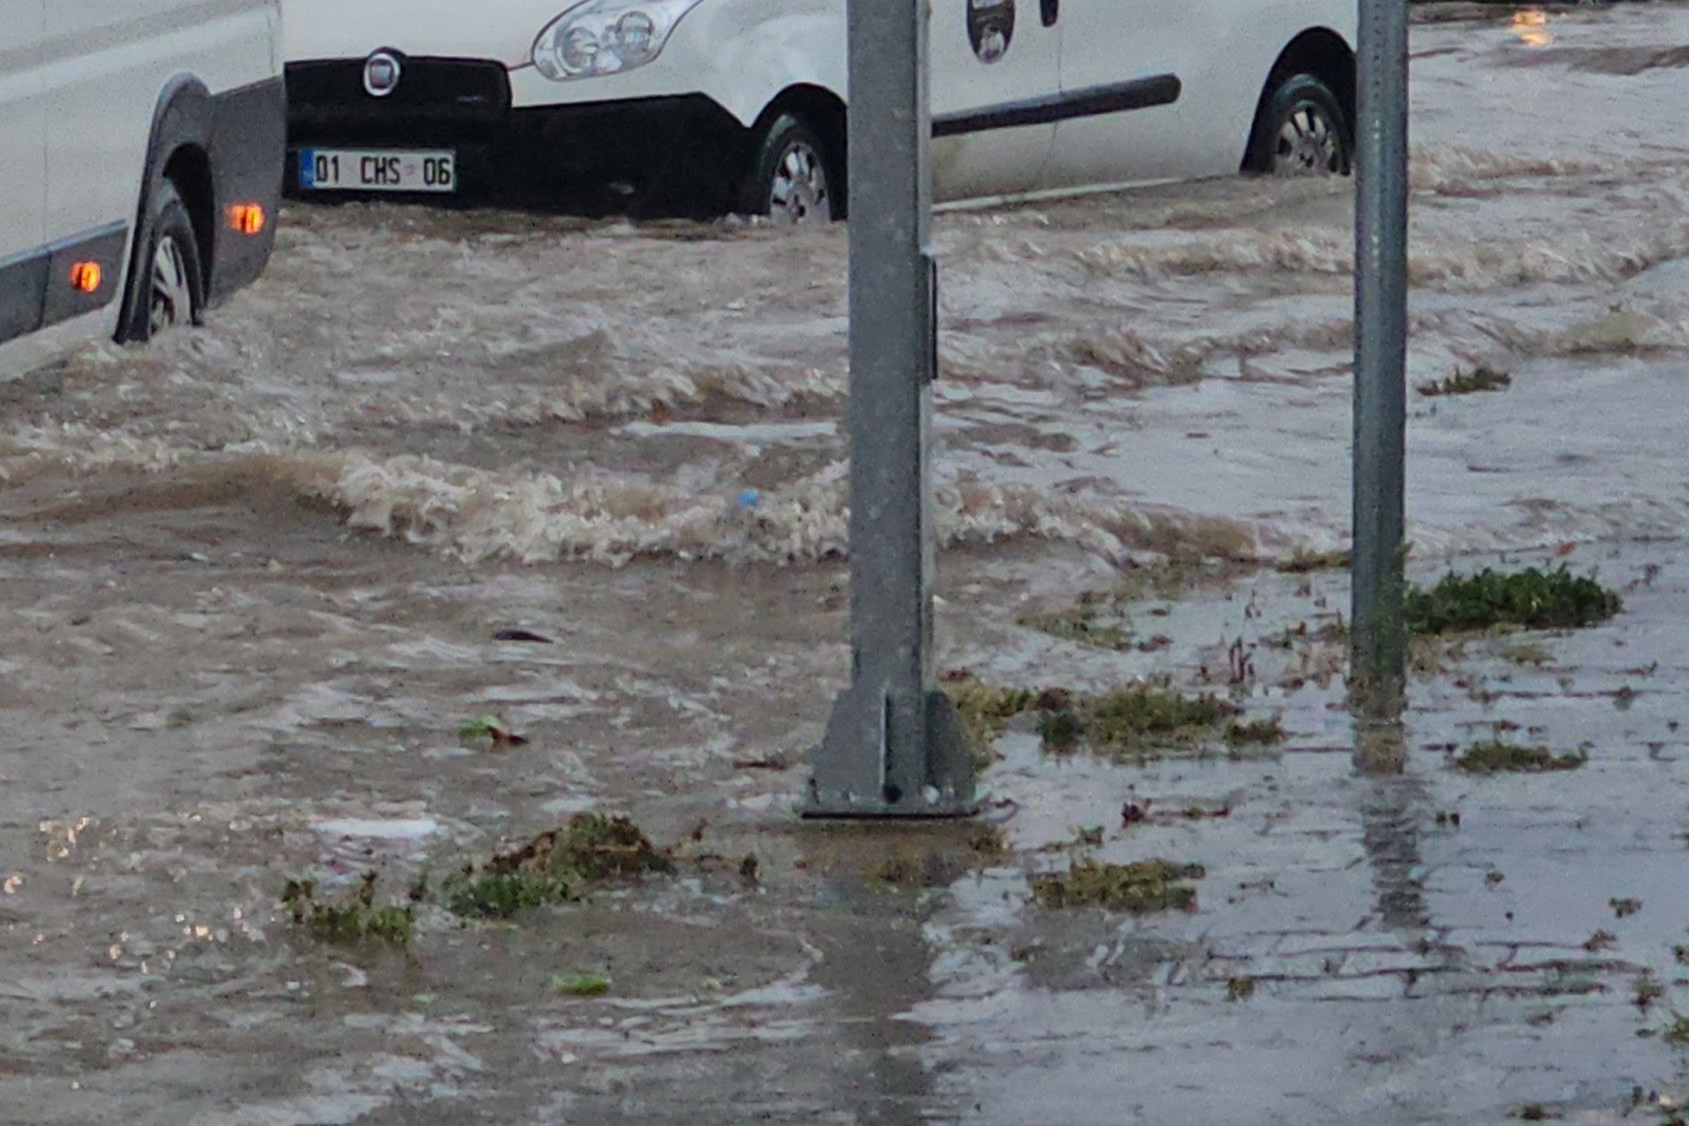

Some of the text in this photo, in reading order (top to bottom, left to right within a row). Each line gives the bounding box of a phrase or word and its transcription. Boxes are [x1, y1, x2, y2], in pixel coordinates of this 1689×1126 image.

[315, 154, 451, 186] 01 CHS 06
